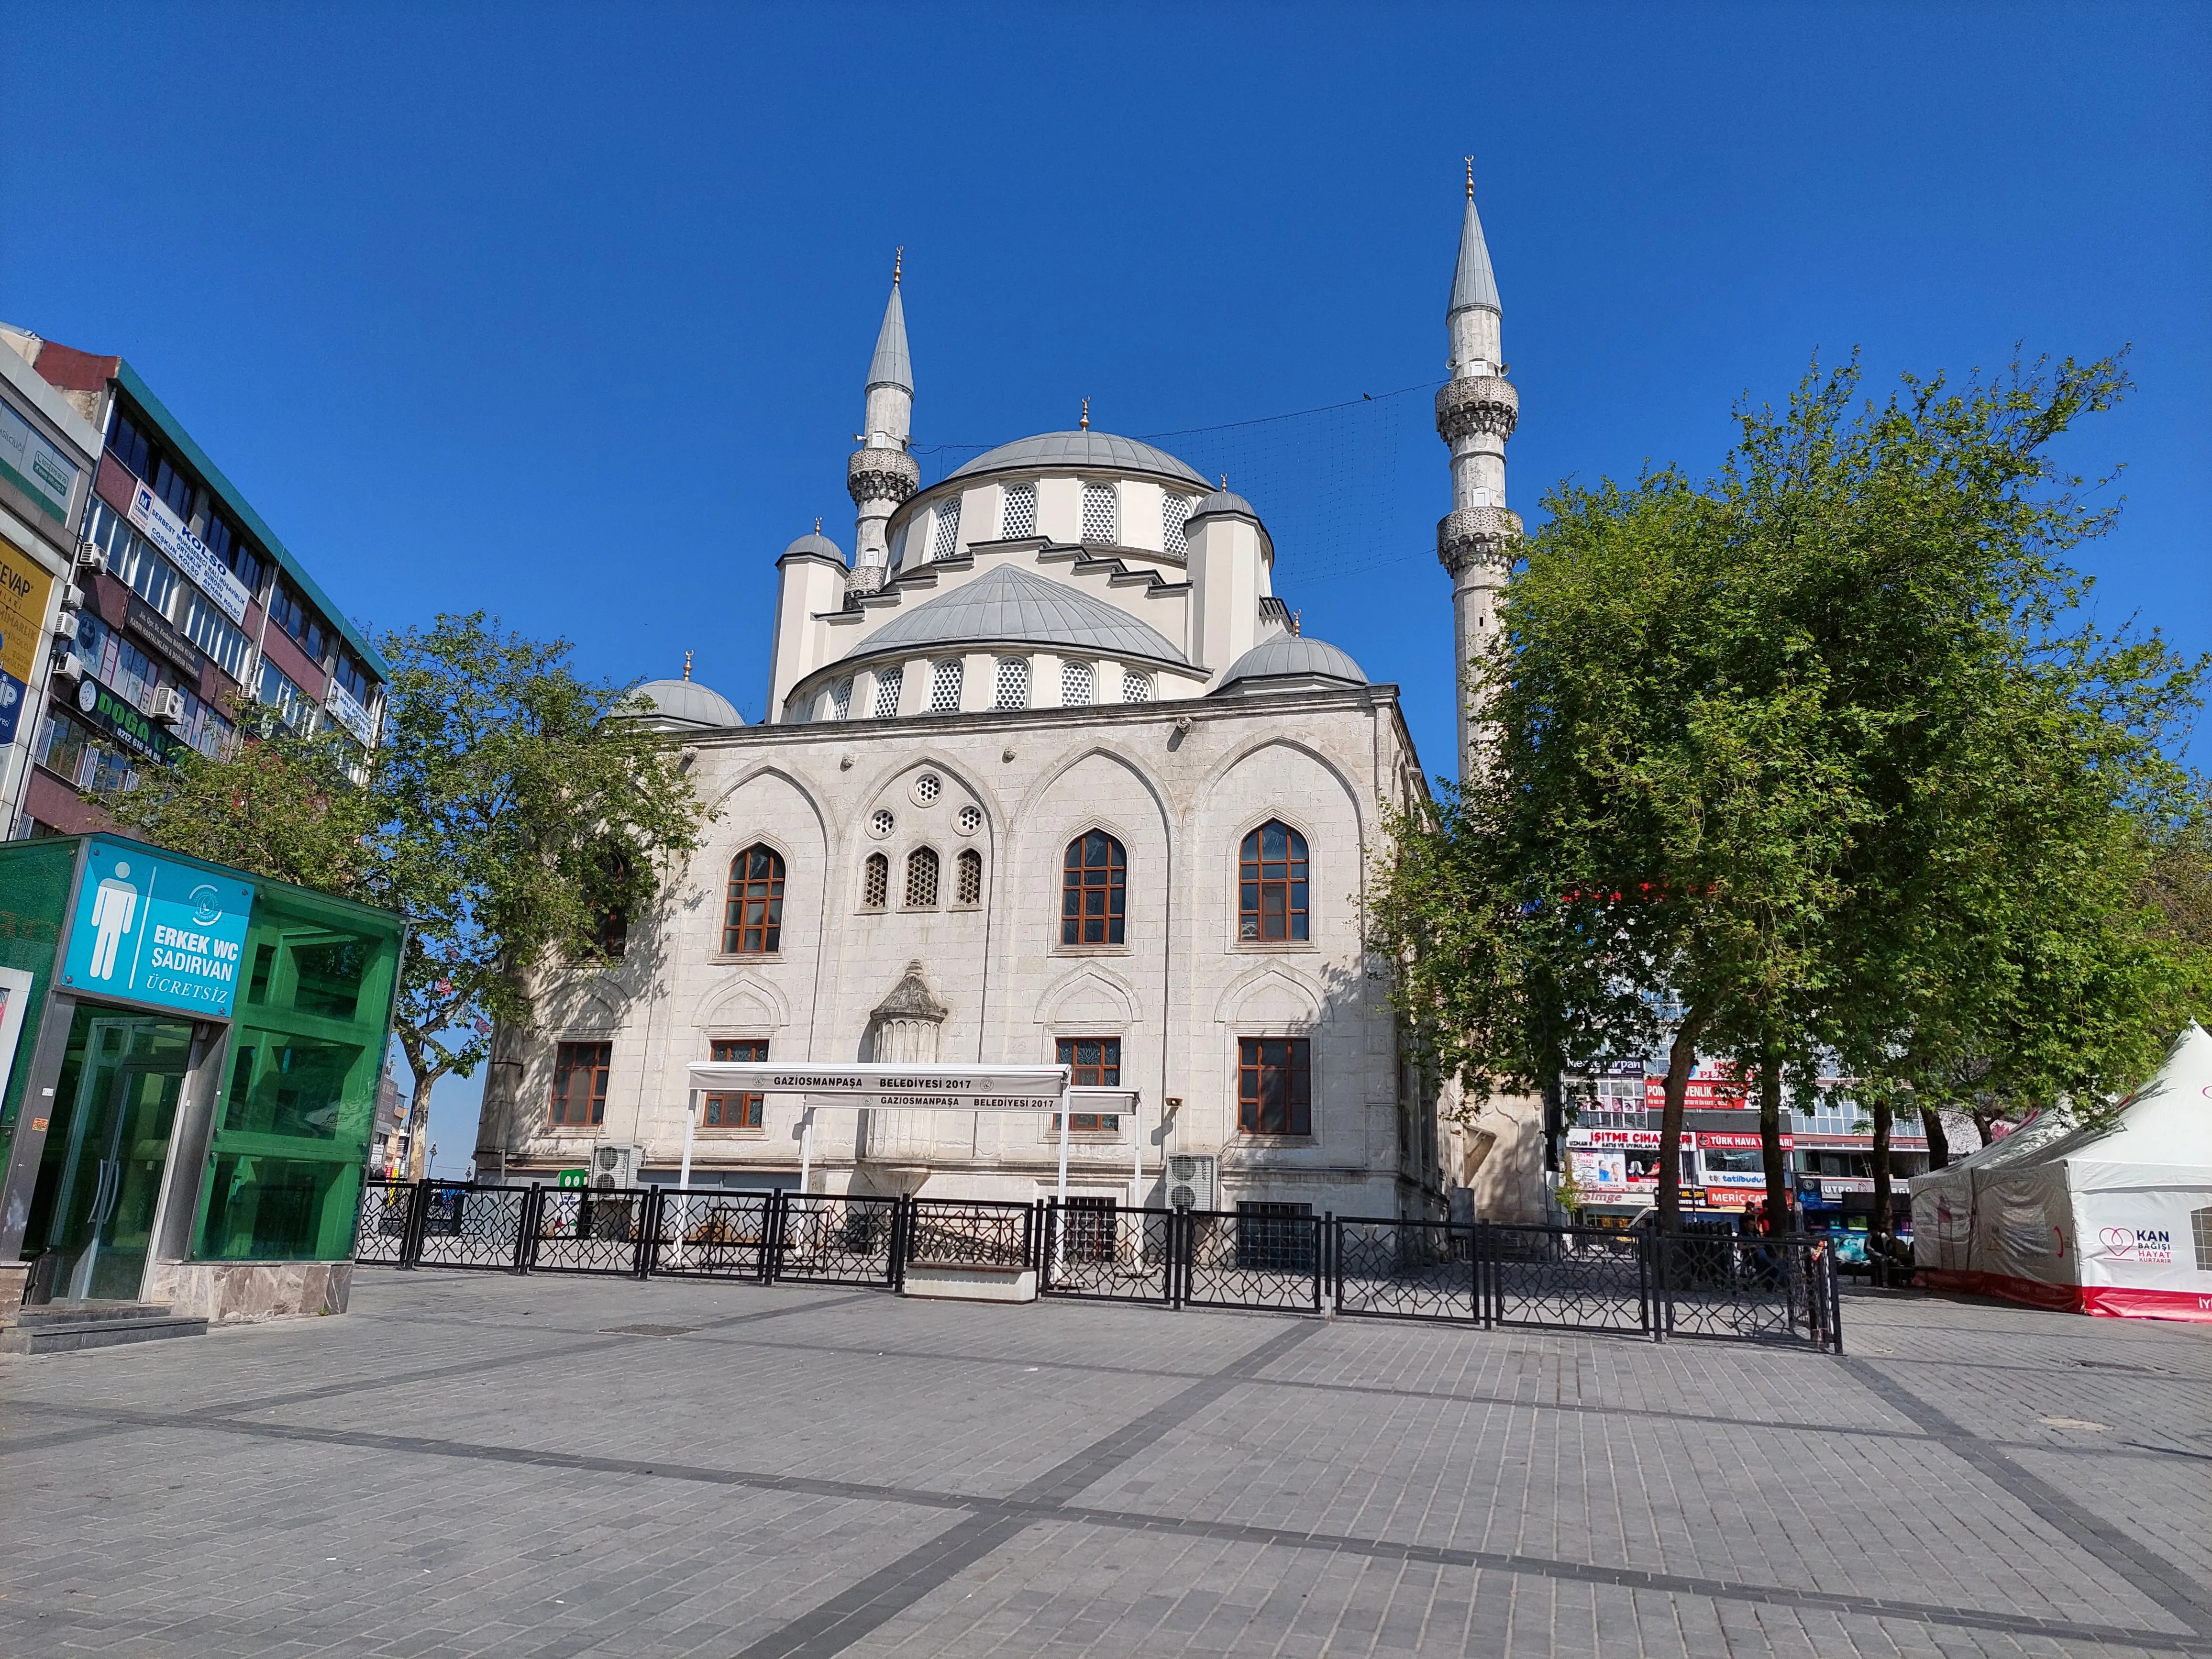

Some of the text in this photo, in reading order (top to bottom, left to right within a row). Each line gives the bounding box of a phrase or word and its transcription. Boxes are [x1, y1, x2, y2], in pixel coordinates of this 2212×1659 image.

[151, 508, 175, 536] SERBEST
[176, 531, 208, 568] MUHASEBECİ
[207, 564, 219, 580] MALİ
[219, 575, 245, 607] MÜŞAVİRLİK
[181, 526, 227, 577] KOLSO
[176, 542, 223, 592] ORTAKLIK BÜROSU
[178, 553, 199, 577] KOLSO
[0, 560, 30, 597] EVAP
[202, 577, 240, 617] AYHAN KOLSO
[130, 617, 142, 632] KADIN
[340, 695, 351, 709] MALİ
[98, 693, 149, 742] DOĞA
[117, 728, 131, 741] 0212
[133, 738, 143, 751] 616
[153, 753, 161, 763] 04
[154, 925, 239, 961] ERKEK WC
[152, 948, 233, 982] ŞADIRVAN
[147, 973, 228, 1003] ÜCRETSİZ
[774, 1075, 971, 1089] GAZİOSMANPAŞA BELEDİYESİ 2017
[1647, 1083, 1665, 1096] POİN
[1685, 1084, 1713, 1097] VENLİK
[881, 1095, 959, 1107] GAZİOSMANPAŞA
[974, 1097, 1029, 1107] BELEDİYESİ
[1591, 1132, 1629, 1144] İŞİTME
[1710, 1135, 1792, 1146] TÜRK HAVA YARI
[1712, 1191, 1746, 1204] MERİÇ
[2136, 1230, 2169, 1242] KAN
[2138, 1242, 2170, 1251] BAĞIŞI
[2199, 1297, 2212, 1309] İY
